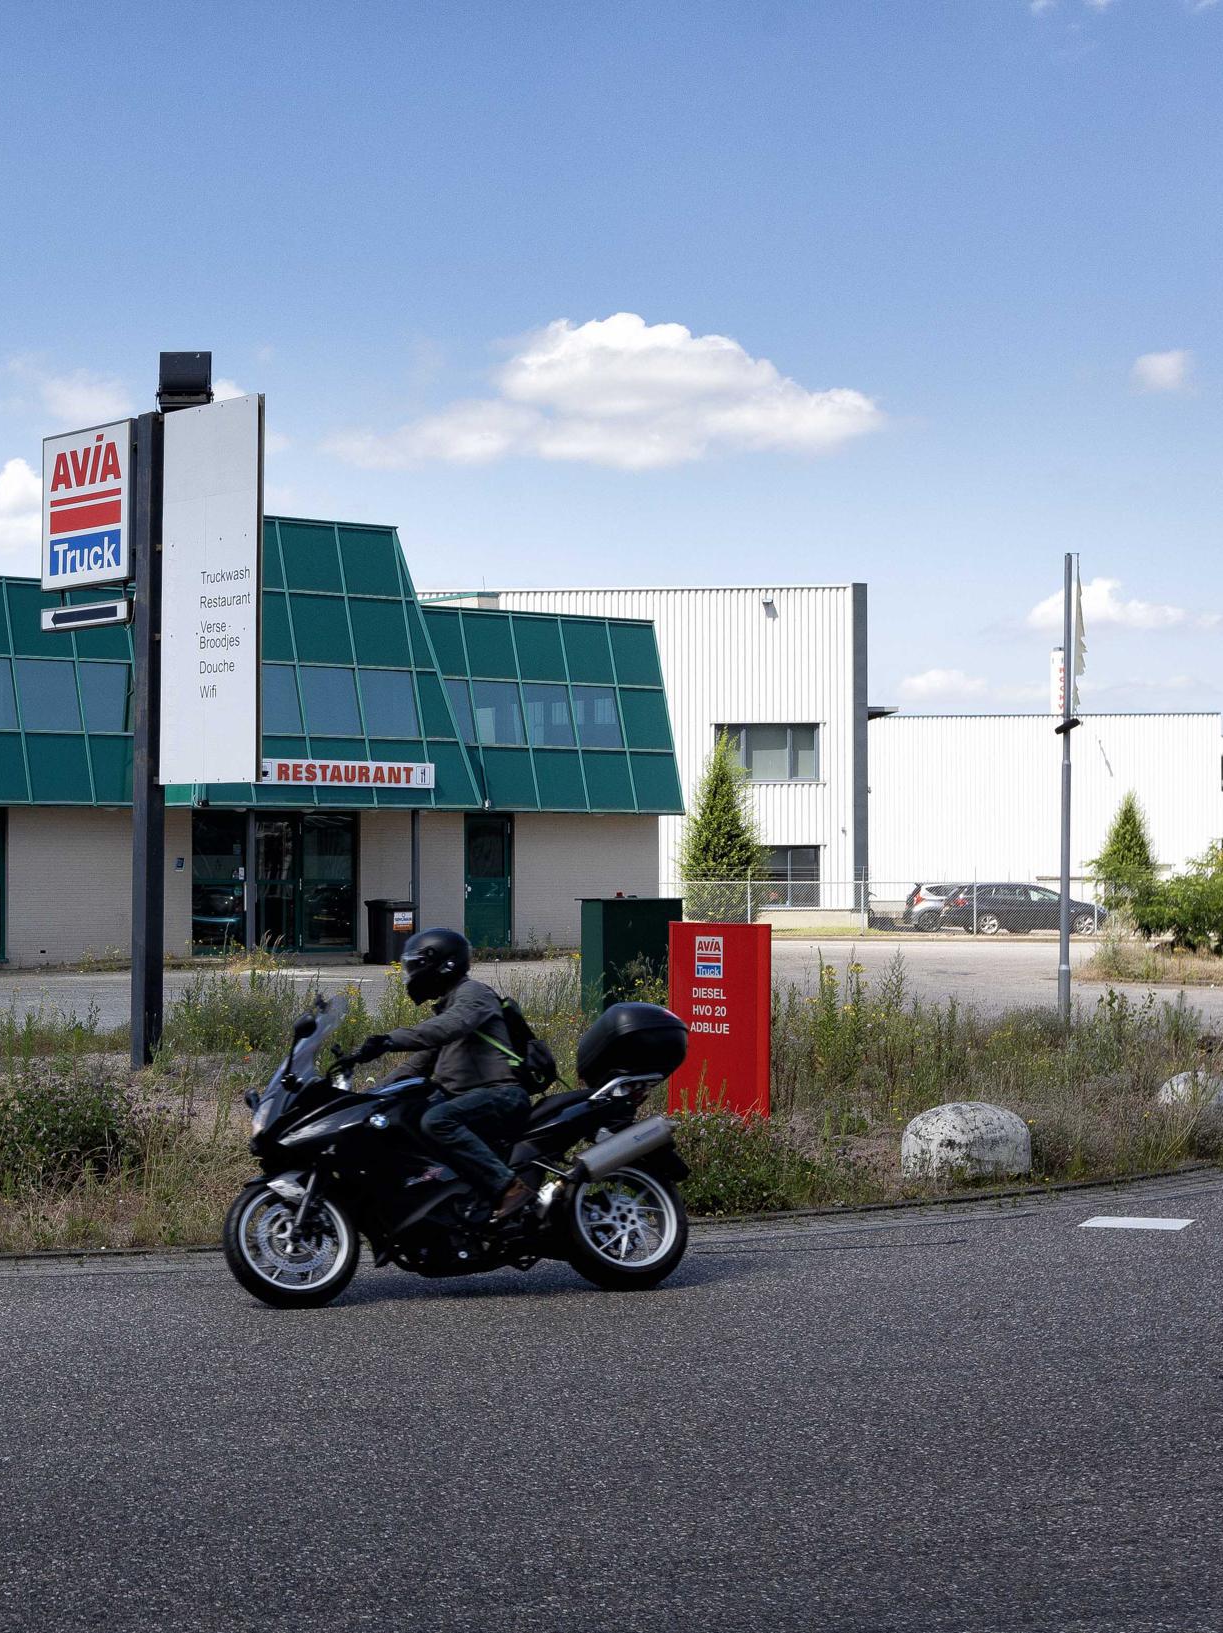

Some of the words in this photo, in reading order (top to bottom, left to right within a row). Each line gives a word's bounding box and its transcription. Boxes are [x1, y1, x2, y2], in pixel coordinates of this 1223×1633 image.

[54, 536, 116, 576] Truck
[201, 566, 250, 584] Truckwash
[200, 592, 251, 608] Restaurant
[199, 634, 240, 650] Broodjes
[199, 660, 235, 674] Douche
[200, 685, 217, 698] Wifi
[277, 763, 413, 784] RESTAURANT
[697, 966, 720, 976] Truck
[692, 987, 726, 999] DIESEL
[692, 1005, 712, 1016] HVO
[714, 1006, 727, 1017] 20
[690, 1022, 729, 1034] ADBLUE
